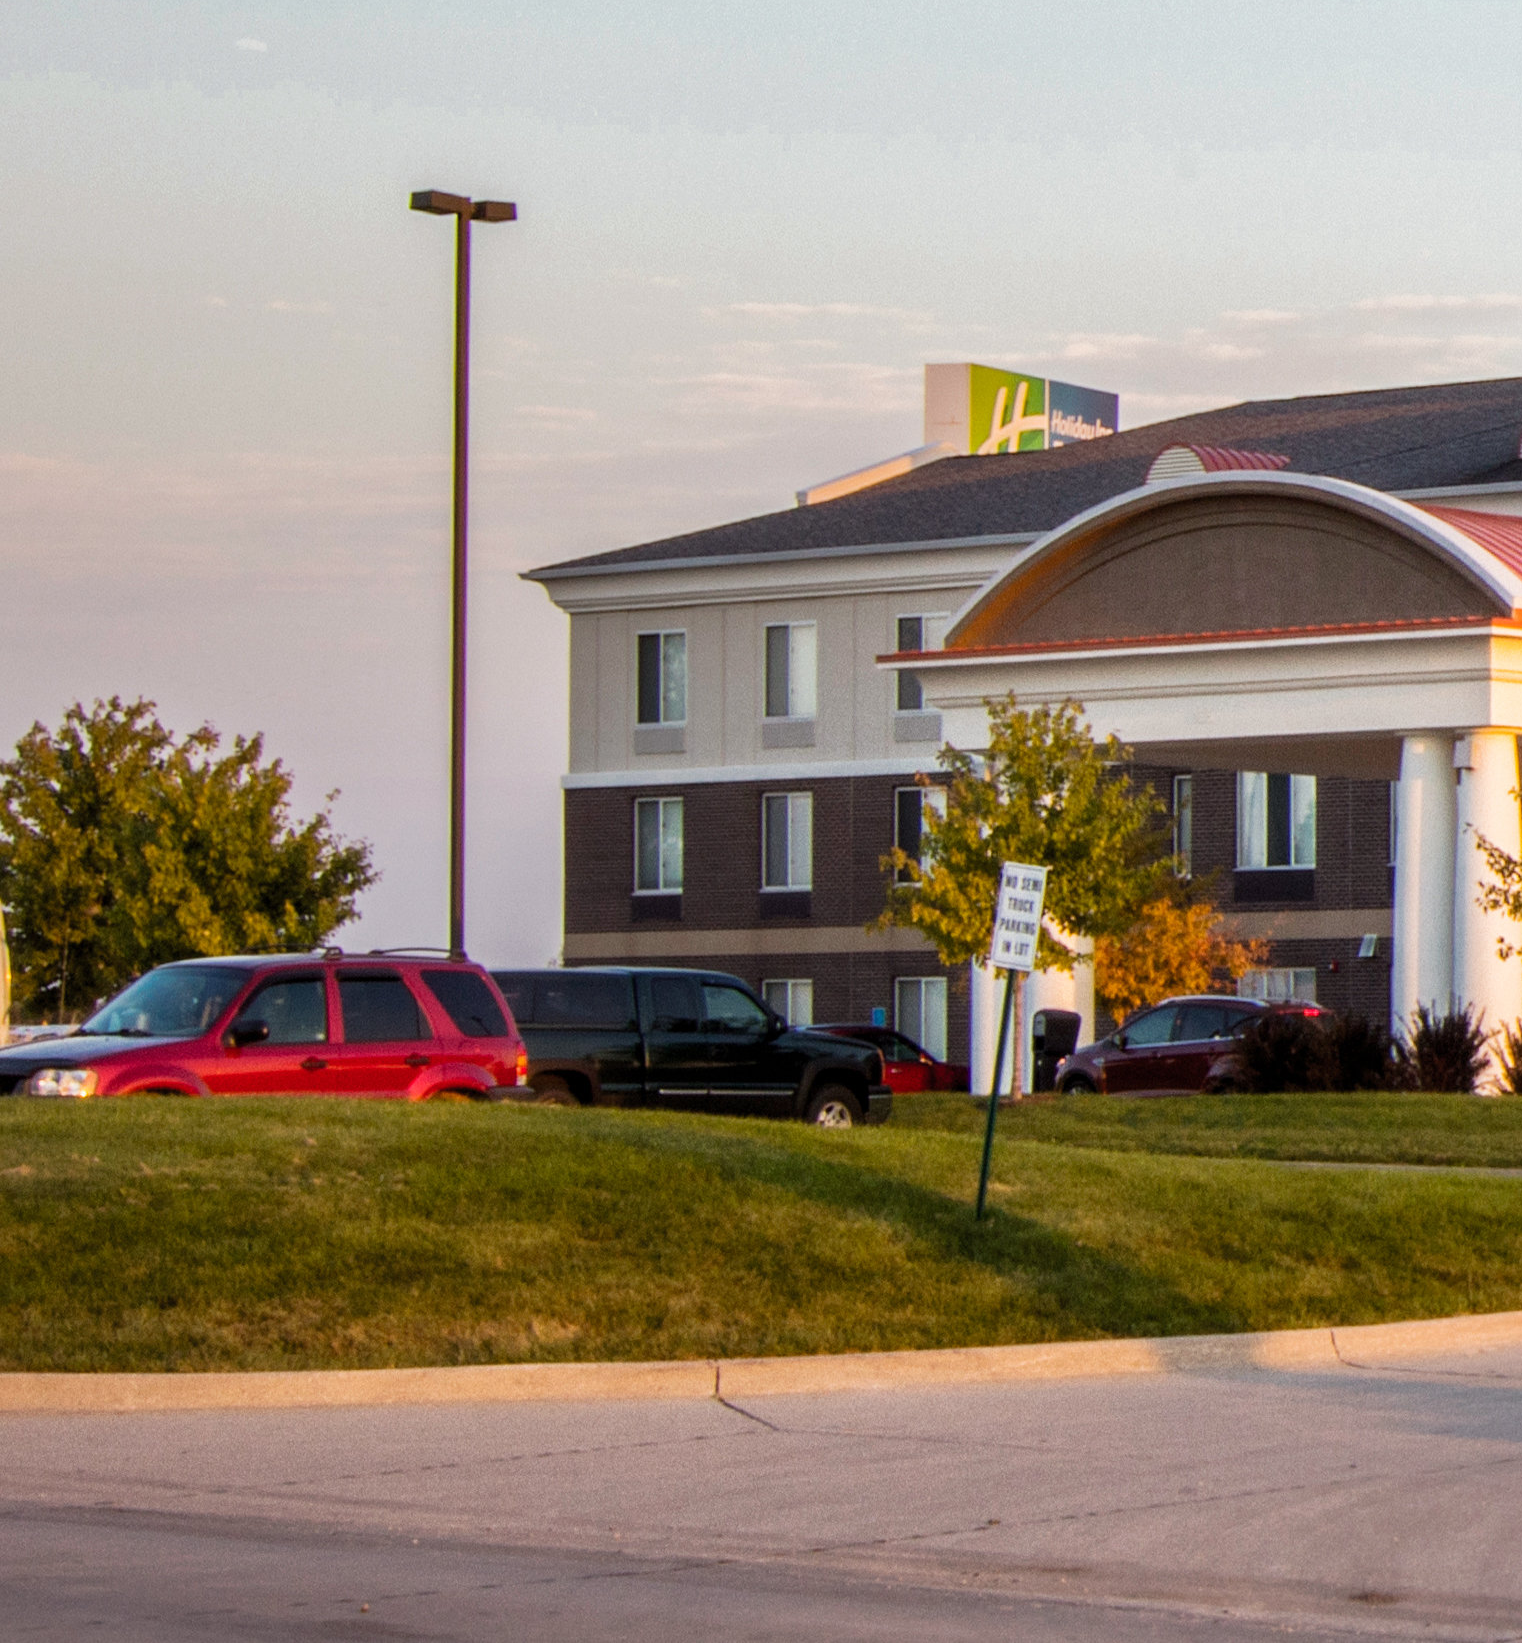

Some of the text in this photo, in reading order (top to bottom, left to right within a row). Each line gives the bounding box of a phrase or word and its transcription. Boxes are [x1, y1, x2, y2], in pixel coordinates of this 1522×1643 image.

[1051, 409, 1095, 440] Holiday
[1005, 875, 1042, 892] NO SEMI
[1008, 897, 1034, 913] TRUCK
[1000, 918, 1036, 935] PARKING
